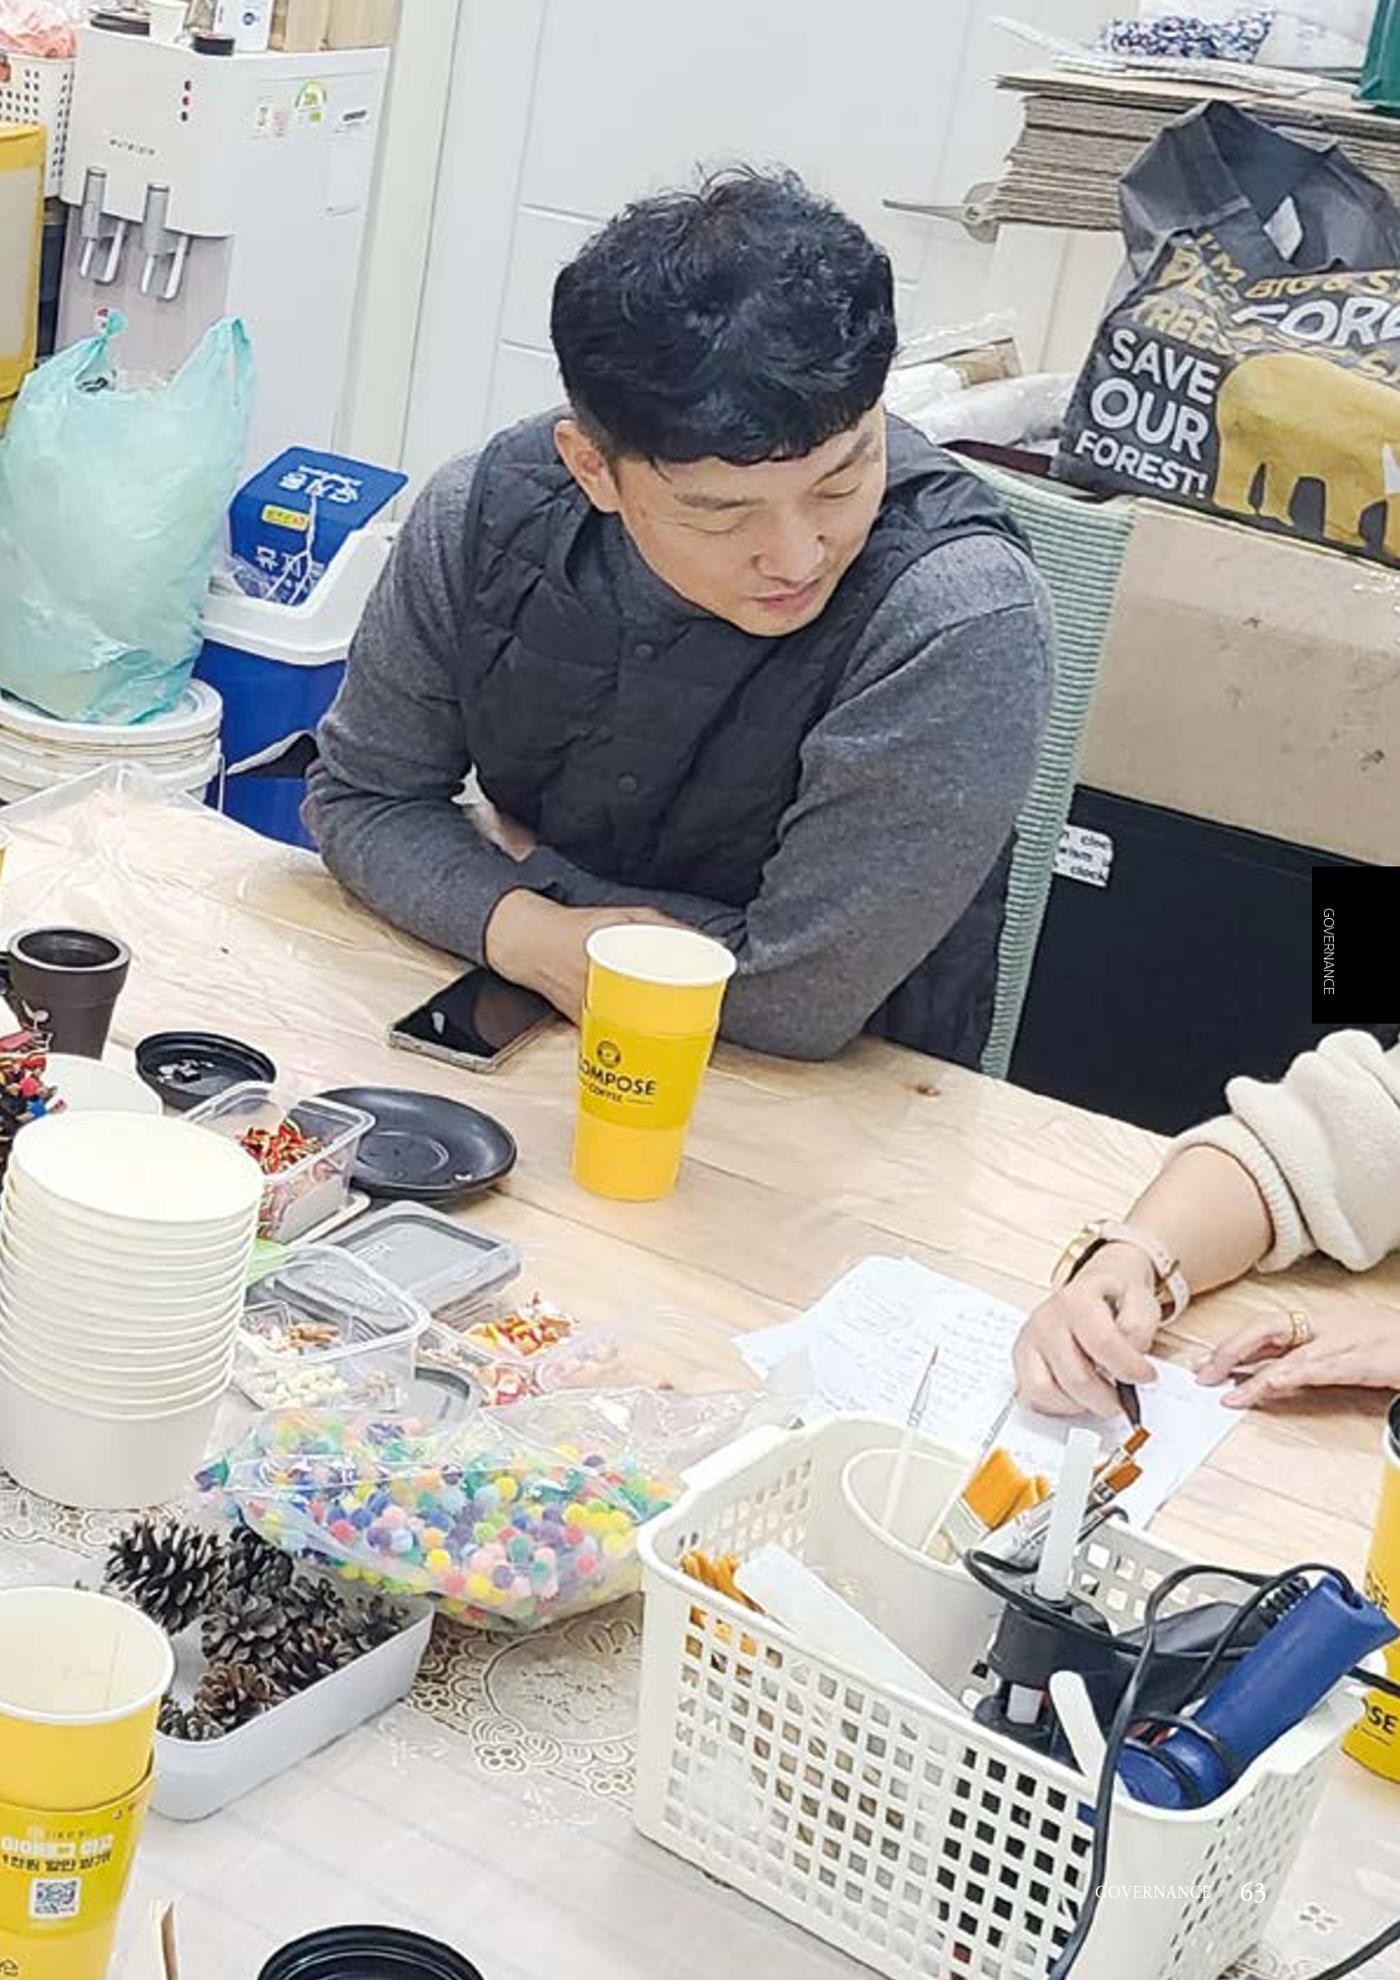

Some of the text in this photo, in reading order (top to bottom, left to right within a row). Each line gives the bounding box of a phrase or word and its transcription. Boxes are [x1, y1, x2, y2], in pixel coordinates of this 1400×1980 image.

[1245, 276, 1313, 299] BIG
[1108, 329, 1221, 404] SAVE
[1090, 380, 1210, 461] OUR
[1075, 430, 1208, 499] FOREST!
[579, 1054, 657, 1095] OMPOSE
